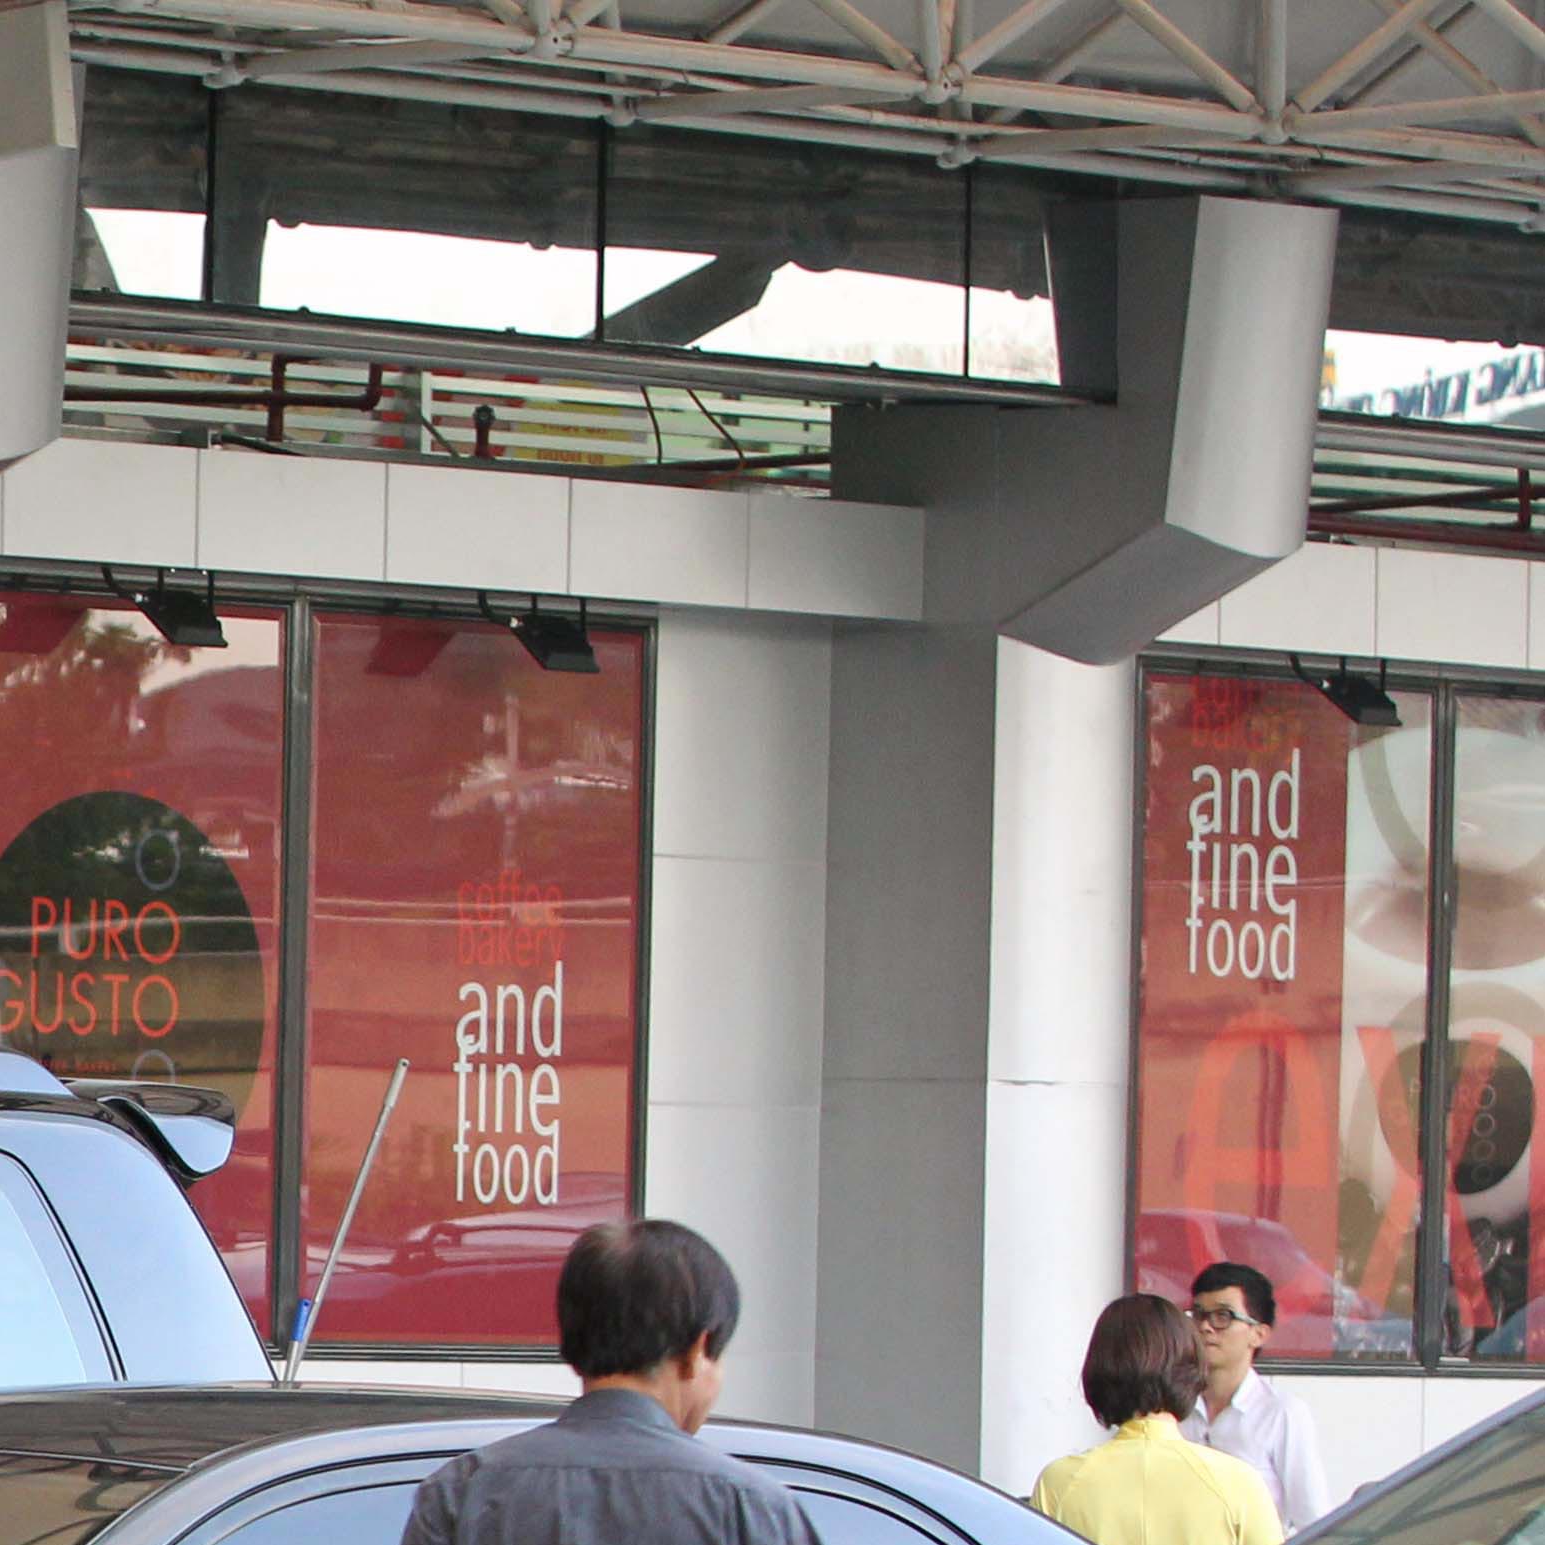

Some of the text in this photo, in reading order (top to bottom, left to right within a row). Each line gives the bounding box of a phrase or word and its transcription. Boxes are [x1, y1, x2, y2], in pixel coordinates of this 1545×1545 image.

[1189, 747, 1301, 841] and
[1185, 813, 1299, 917] fine
[30, 895, 182, 965] PURO
[1185, 896, 1296, 981] food
[456, 960, 564, 1058] and
[452, 1033, 561, 1138] fine
[452, 1118, 560, 1206] food
